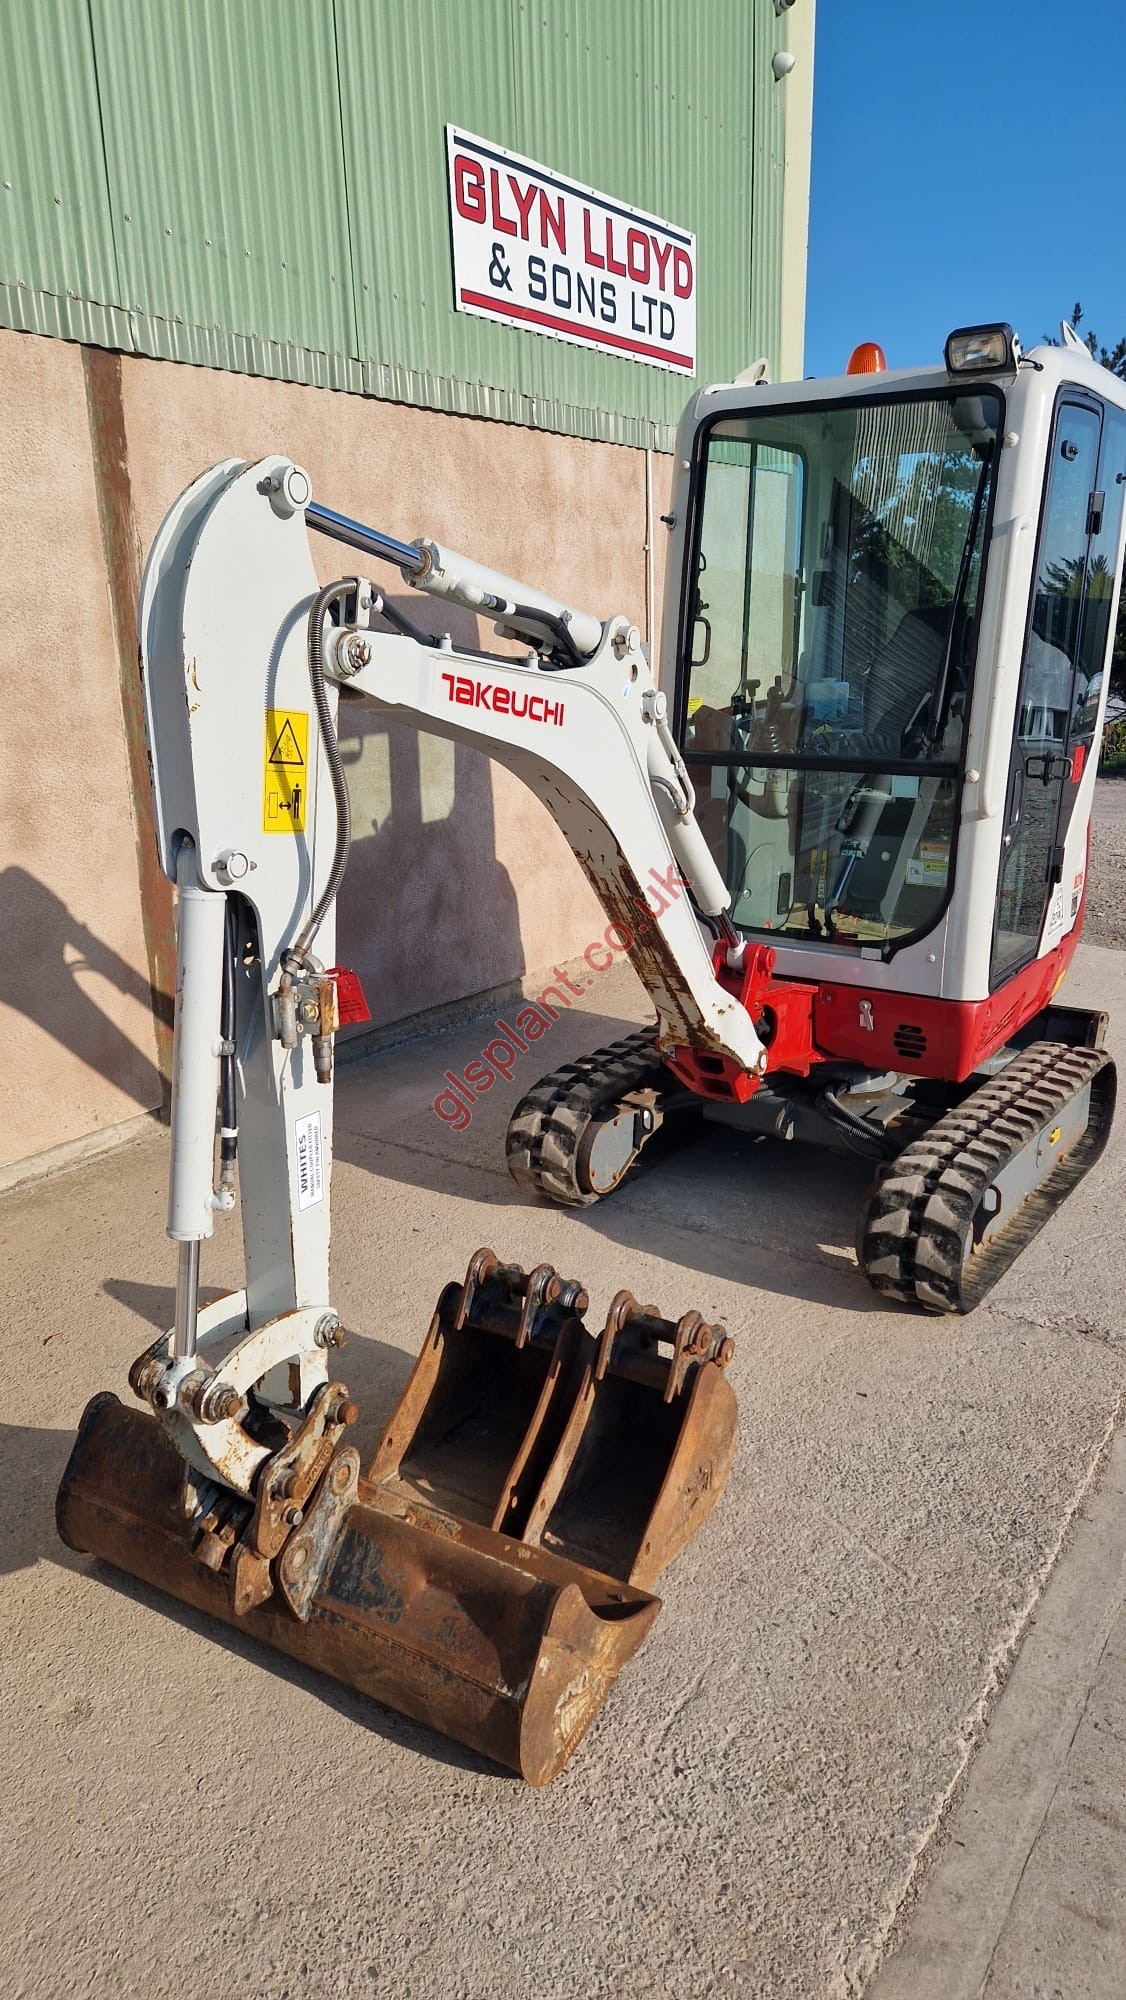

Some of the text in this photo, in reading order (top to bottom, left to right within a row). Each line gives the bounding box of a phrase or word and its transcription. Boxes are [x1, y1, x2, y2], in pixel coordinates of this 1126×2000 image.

[454, 154, 693, 299] GLYN LLOYD
[488, 242, 675, 340] & SONS LTD
[299, 1134, 308, 1194] WHITES
